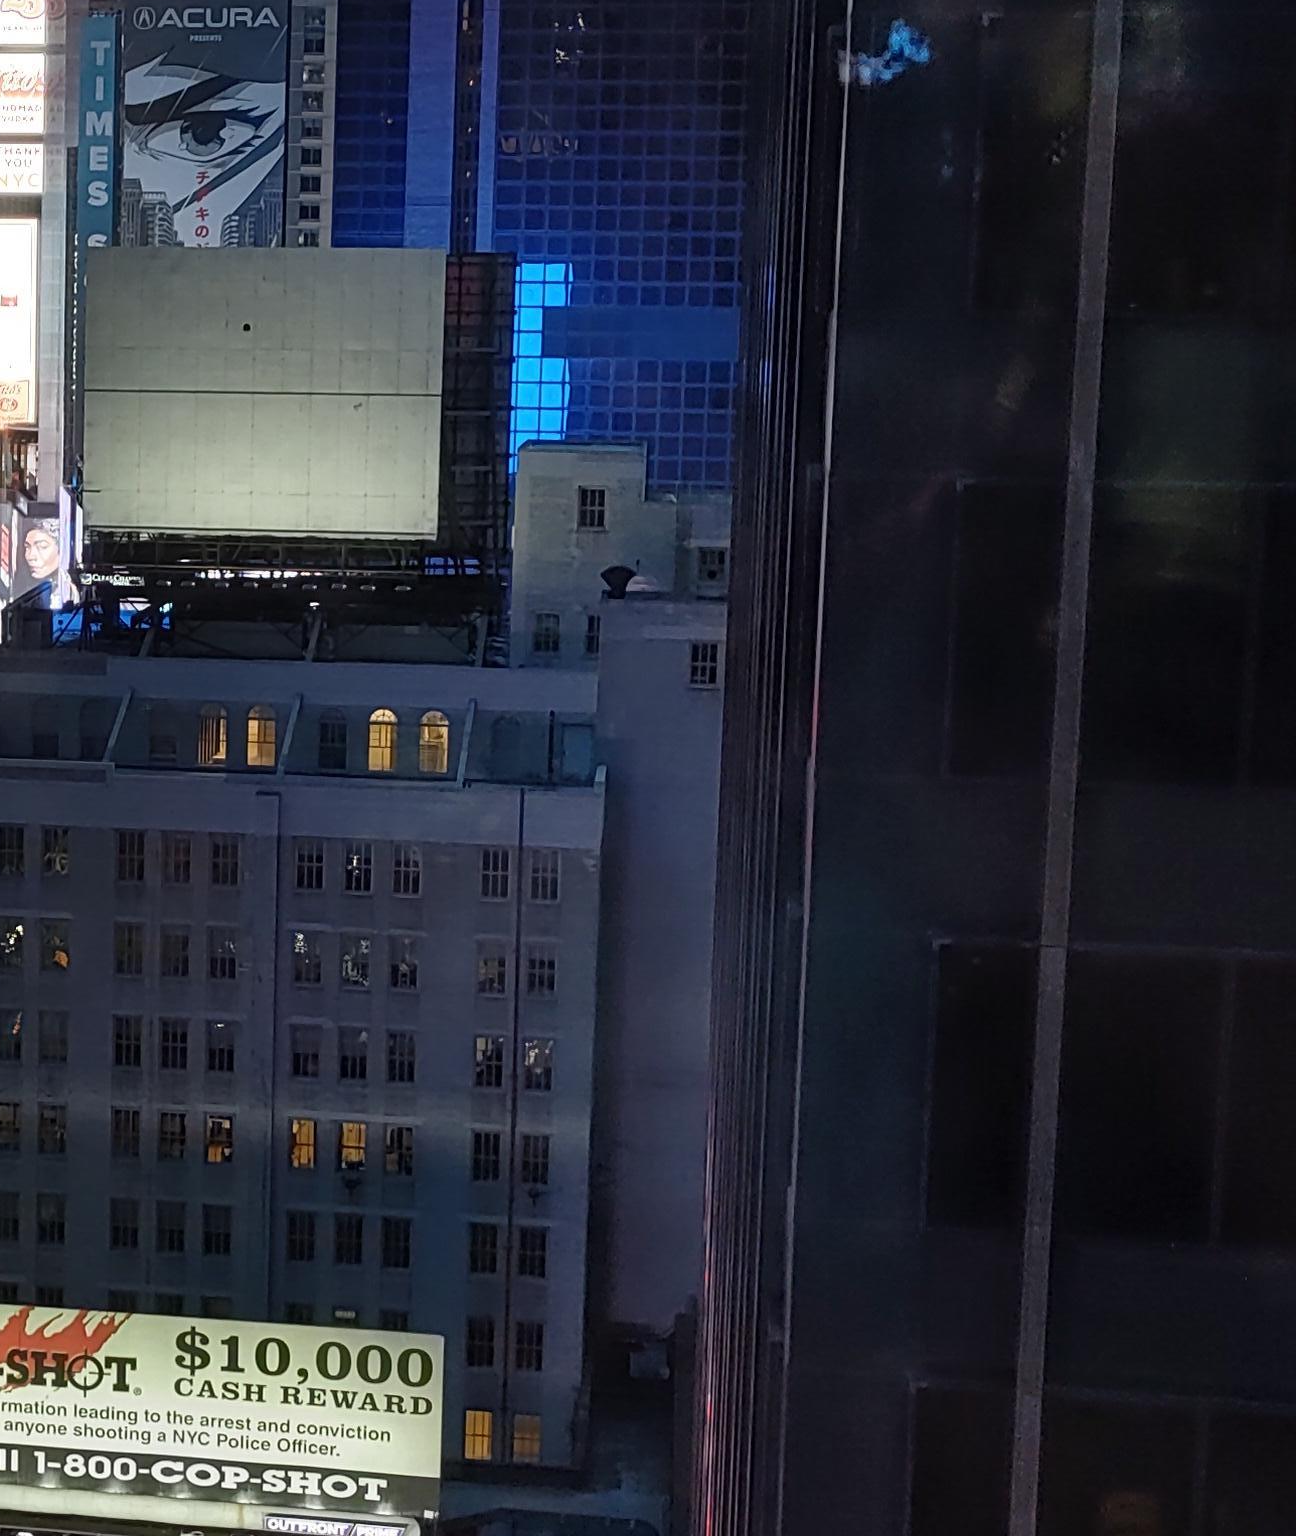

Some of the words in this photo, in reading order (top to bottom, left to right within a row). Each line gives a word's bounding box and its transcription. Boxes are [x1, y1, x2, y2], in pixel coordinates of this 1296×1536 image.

[158, 7, 280, 29] ACURA
[85, 40, 113, 207] TIMES
[5, 158, 32, 168] YOU
[174, 1326, 434, 1388] $10,000
[174, 1377, 267, 1403] CASH
[280, 1385, 434, 1415] REWARD
[4, 1420, 67, 1437] anyone
[73, 1424, 151, 1445] shooting
[157, 1431, 167, 1443] a
[172, 1429, 210, 1446] NYC
[217, 1434, 271, 1451] Police
[277, 1438, 341, 1457] Officer.
[73, 1404, 138, 1425] leading
[144, 1408, 161, 1423] to
[167, 1410, 194, 1425] the
[199, 1415, 251, 1431] arrest
[257, 1419, 290, 1434] and
[296, 1423, 391, 1442] conviction
[33, 1450, 388, 1502] 1-800-COP-SHOT
[266, 1517, 349, 1536] OUTFRONT
